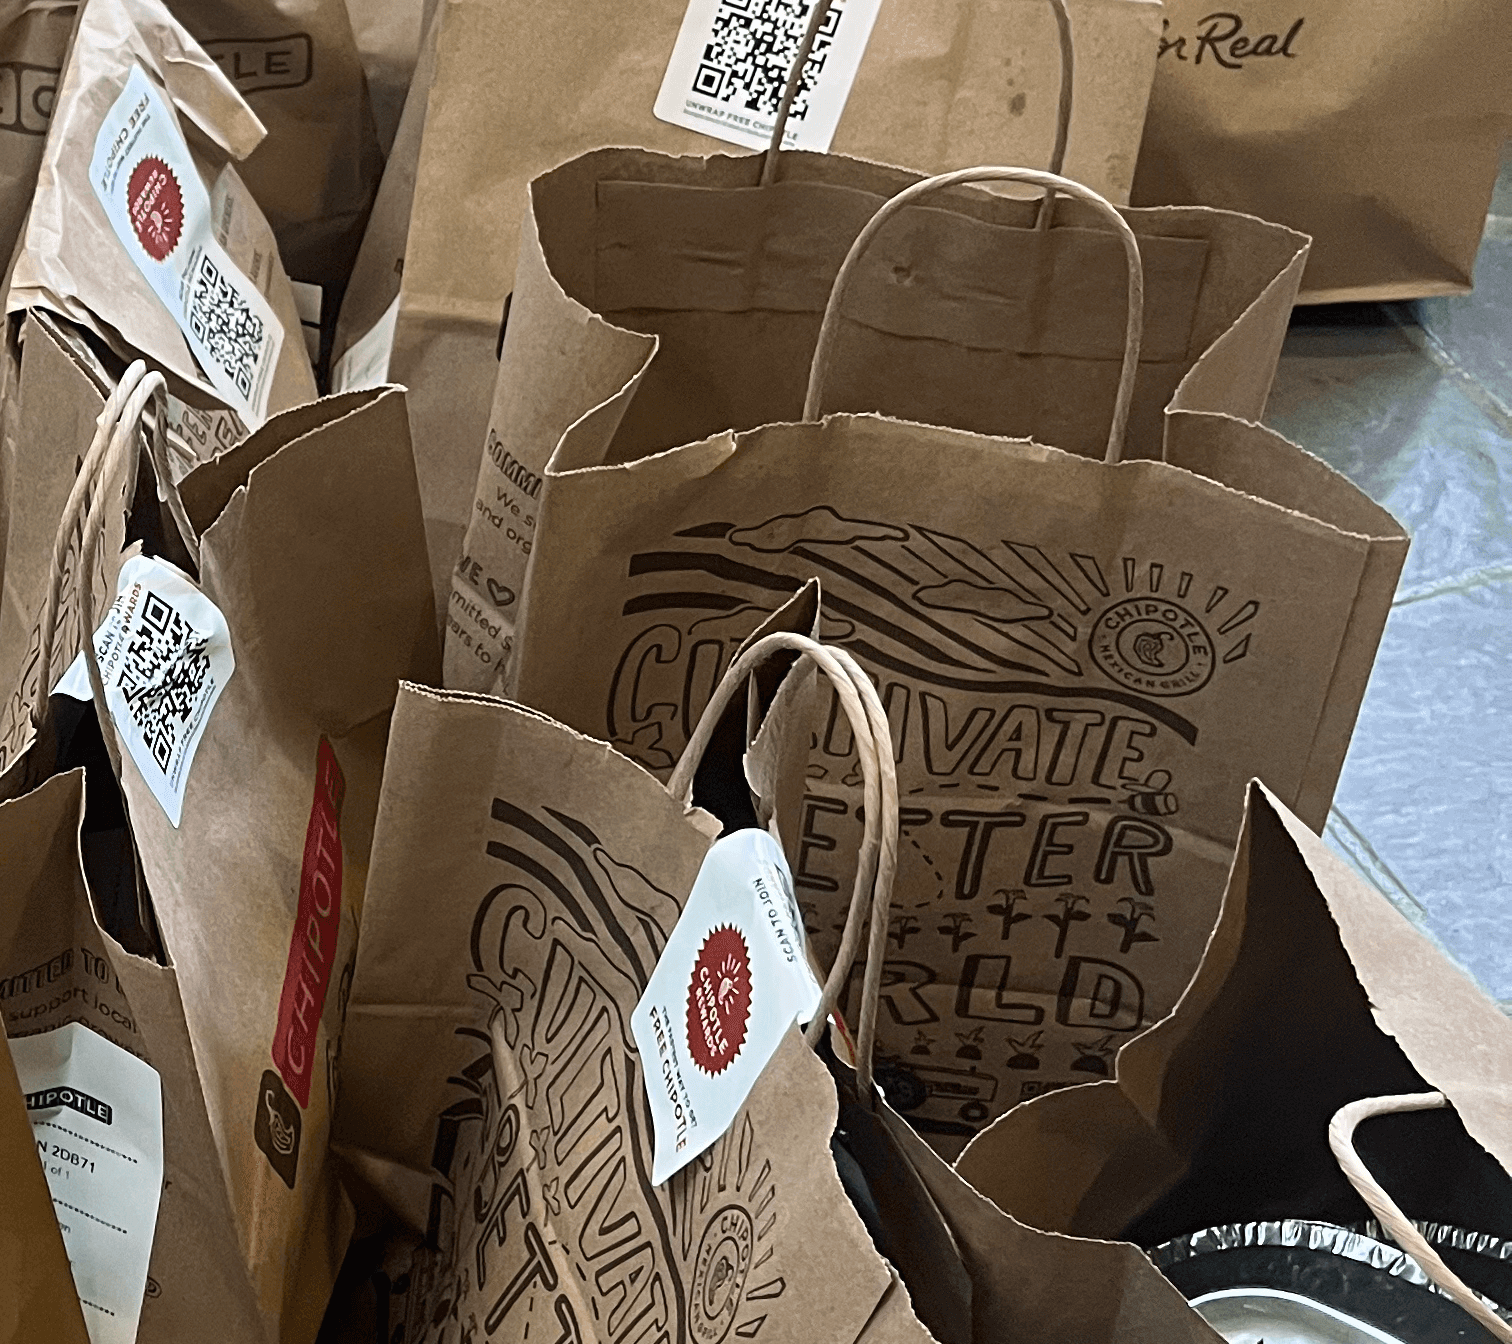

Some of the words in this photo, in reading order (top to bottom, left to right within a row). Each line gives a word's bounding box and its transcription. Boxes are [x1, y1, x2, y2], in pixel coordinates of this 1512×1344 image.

[1194, 10, 1306, 71] Real
[128, 92, 150, 130] FREE
[685, 99, 725, 120] UNWRAP
[726, 111, 751, 127] FREE
[752, 120, 799, 142] CHIPLE
[474, 498, 504, 529] and
[496, 486, 521, 516] We
[452, 590, 503, 640] mitted
[1104, 603, 1209, 657] CHIPOTLE
[96, 629, 115, 663] SCAN
[474, 642, 493, 664] to
[1099, 643, 1156, 688] MEXICAN
[752, 877, 773, 908] JOIN
[767, 908, 784, 926] TO
[776, 926, 795, 963] SCAN
[80, 947, 110, 985] TO
[8, 987, 89, 1023] support
[93, 995, 138, 1034] local
[694, 986, 719, 1058] REWARDS
[699, 965, 730, 1056] CHIPOTLE
[648, 1005, 668, 1058] FREE
[661, 1058, 688, 1154] CHIPOTLE
[28, 1090, 110, 1119] HIPOTLE
[50, 1166, 62, 1177] of
[51, 1145, 96, 1174] 2DB71
